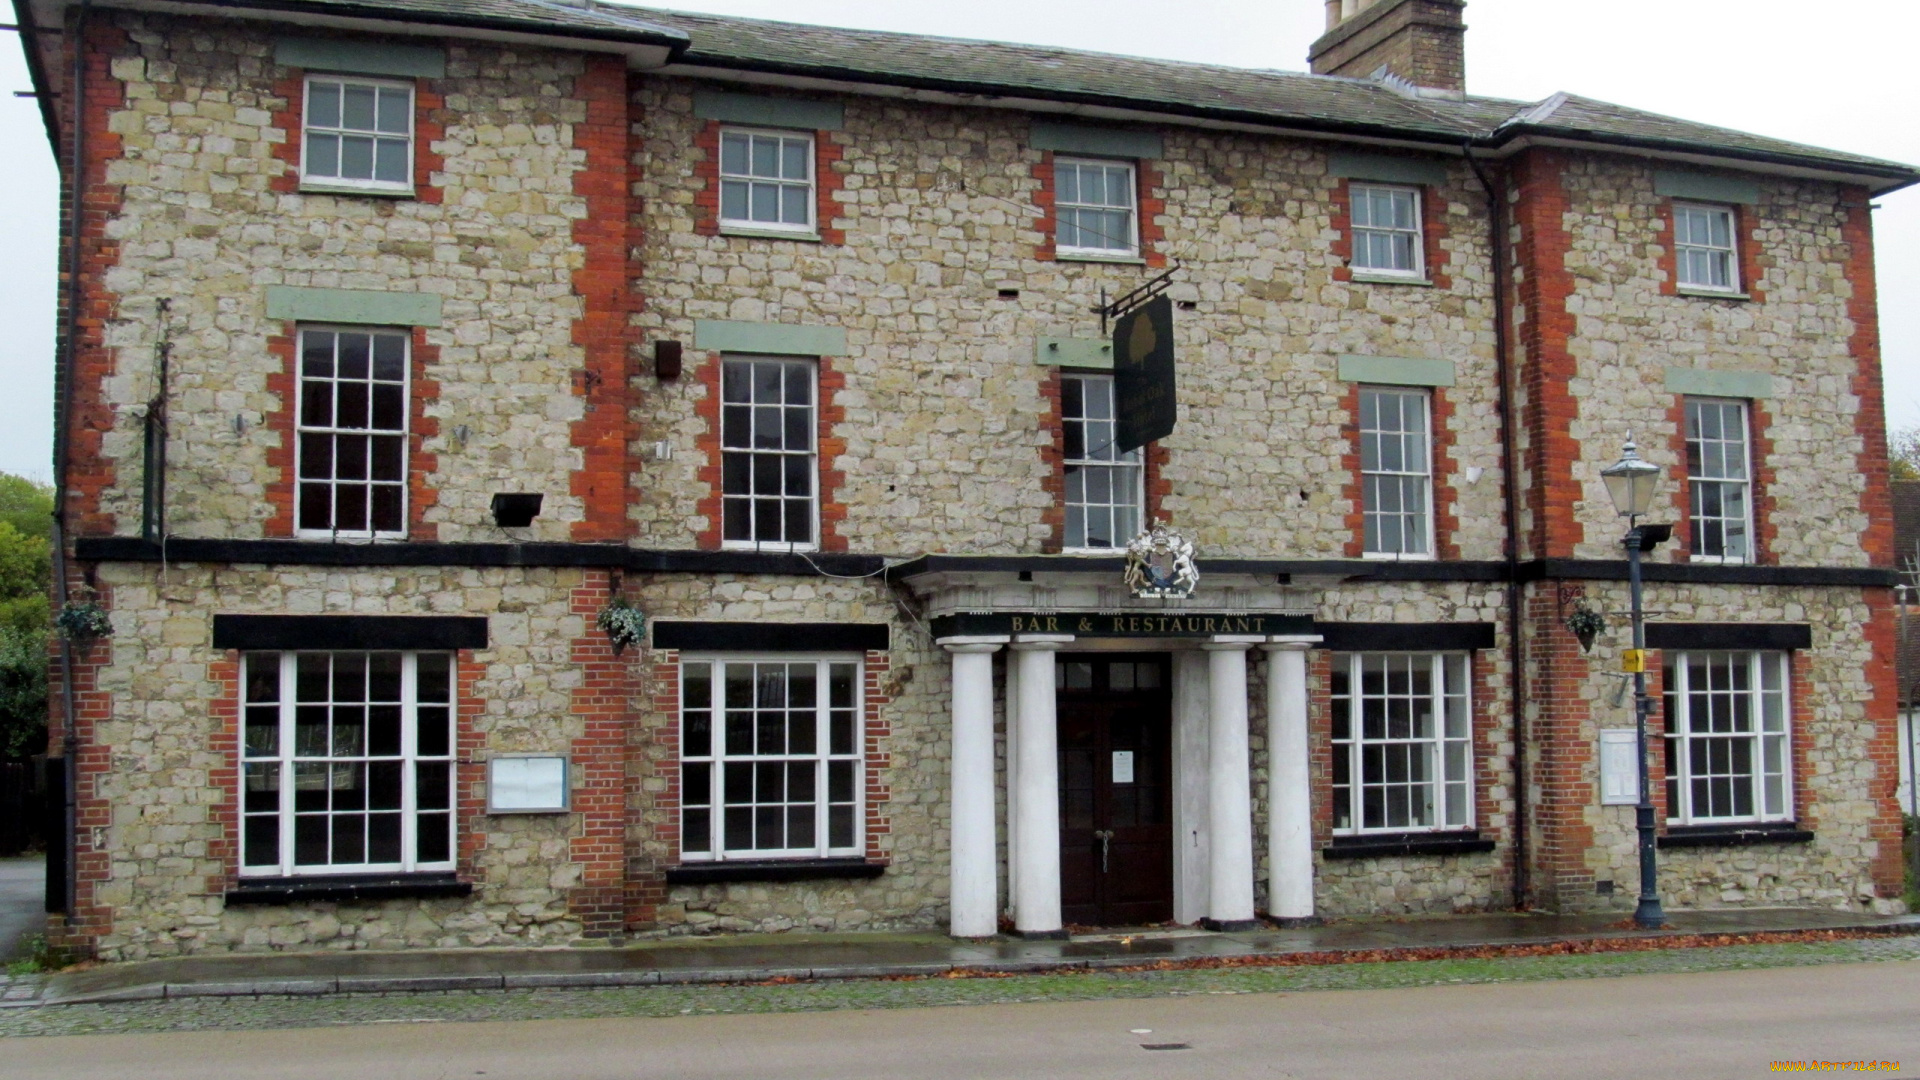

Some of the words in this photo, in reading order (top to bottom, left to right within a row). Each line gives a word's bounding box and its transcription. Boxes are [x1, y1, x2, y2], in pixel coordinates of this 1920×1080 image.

[1012, 616, 1060, 632] BAR
[1078, 616, 1094, 632] &
[1113, 616, 1266, 632] RESTAURANT
